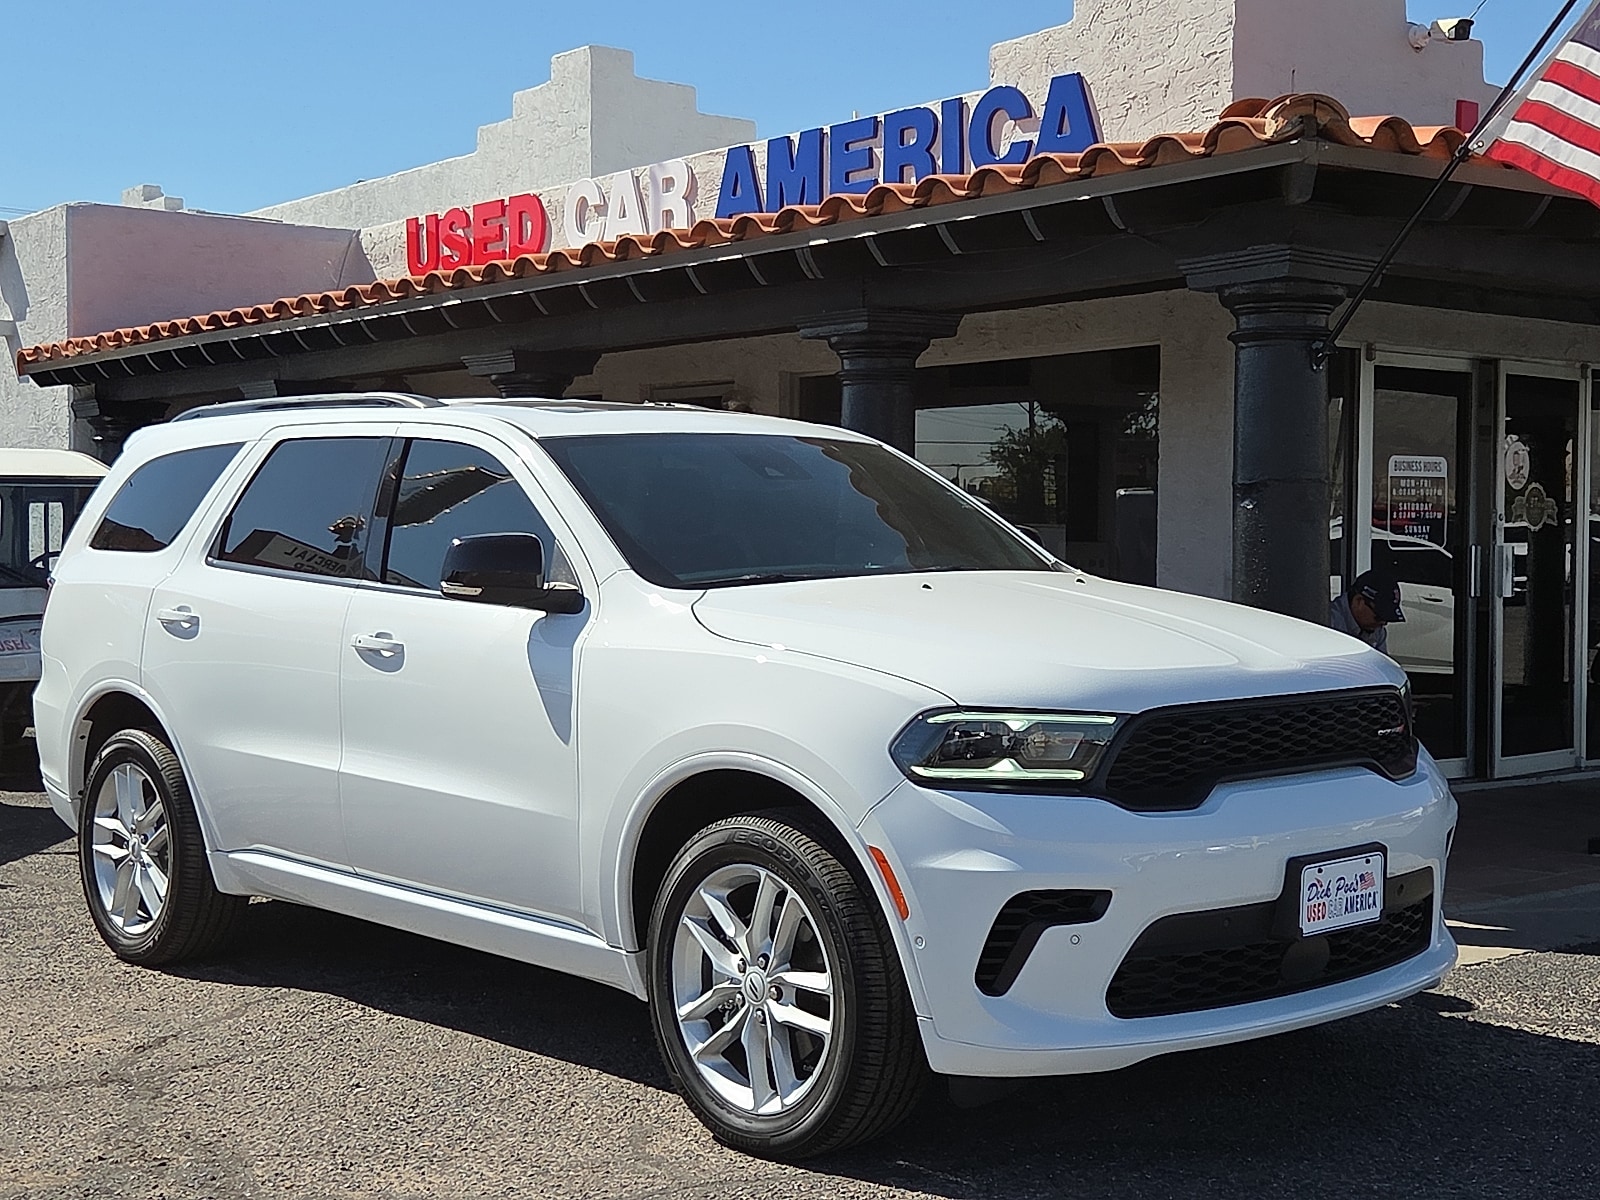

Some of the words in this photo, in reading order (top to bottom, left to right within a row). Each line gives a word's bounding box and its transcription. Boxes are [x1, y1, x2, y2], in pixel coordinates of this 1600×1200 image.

[405, 193, 547, 276] USED
[564, 160, 694, 248] CAR
[714, 71, 1100, 219] AMERICA
[1394, 460, 1422, 472] BUSINESS
[1423, 461, 1442, 473] HOURS
[1398, 502, 1433, 511] SATURDAY
[1404, 525, 1431, 533] SUNDAY
[1307, 878, 1332, 903] Dick
[1306, 901, 1327, 923] USED
[1343, 891, 1377, 915] AMERICA
